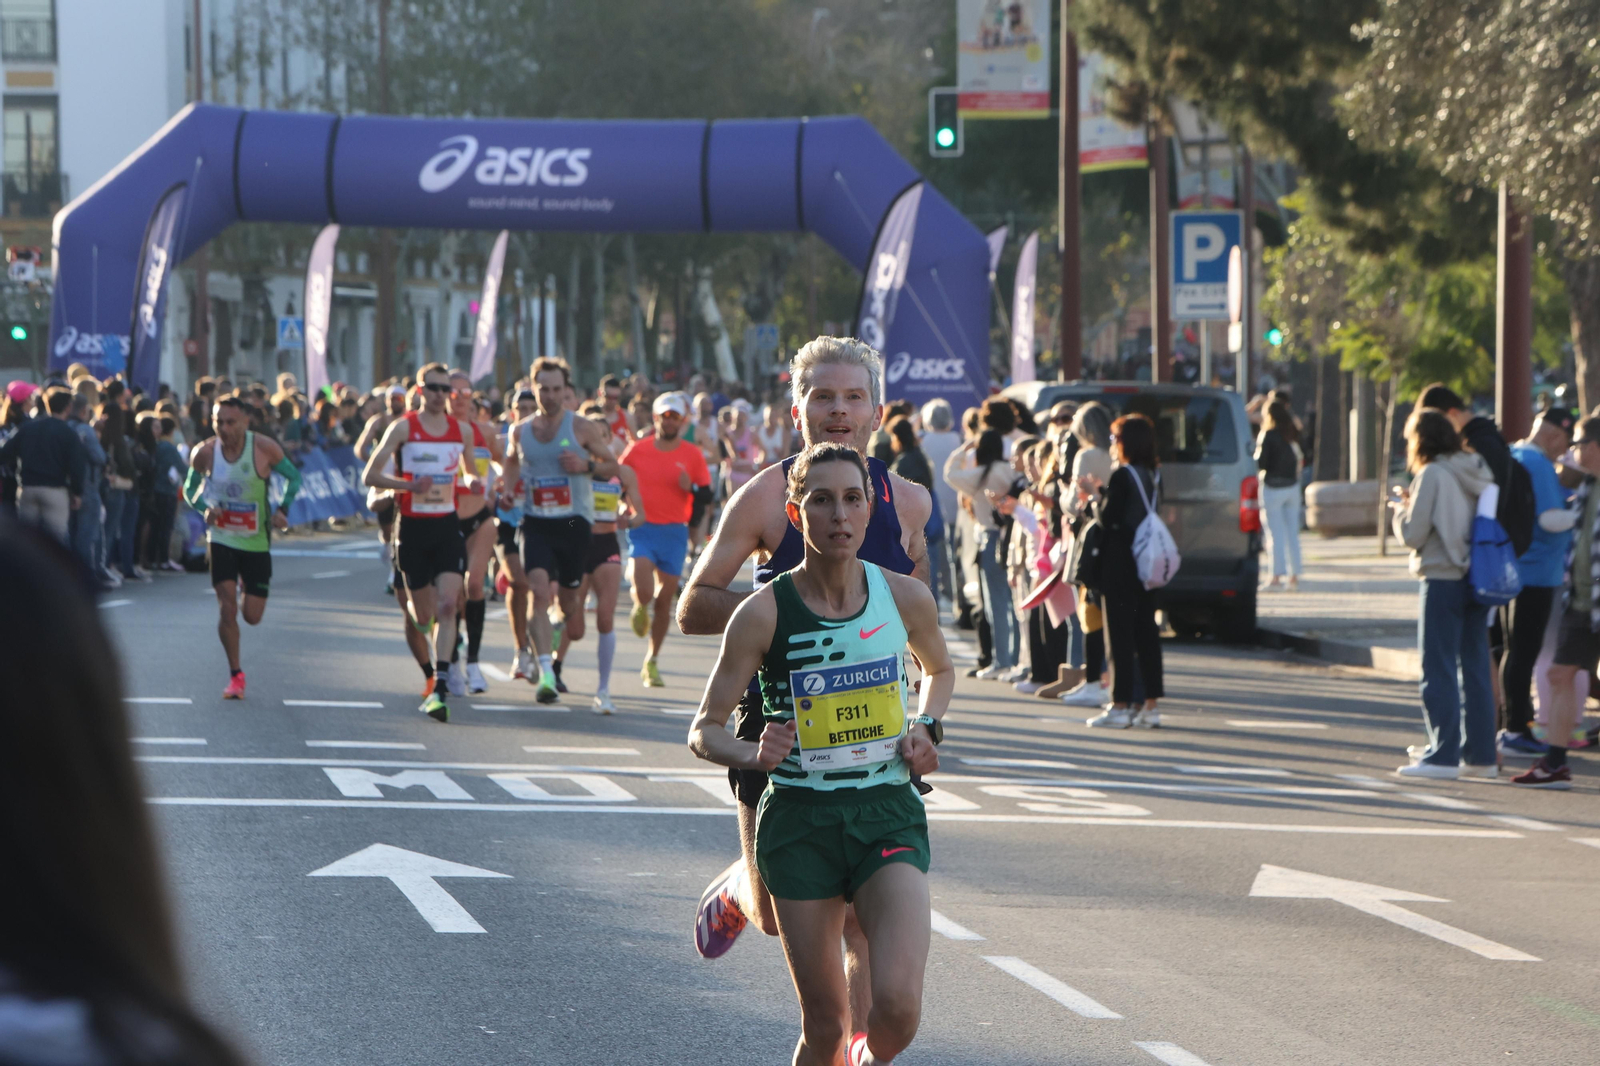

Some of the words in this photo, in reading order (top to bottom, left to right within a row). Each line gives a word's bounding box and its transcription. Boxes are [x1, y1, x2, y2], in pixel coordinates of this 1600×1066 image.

[475, 146, 592, 187] asics
[1182, 222, 1227, 281] P
[908, 357, 966, 380] asics
[832, 666, 890, 688] ZURICH
[836, 703, 869, 722] F311
[829, 725, 884, 745] BETTICHE
